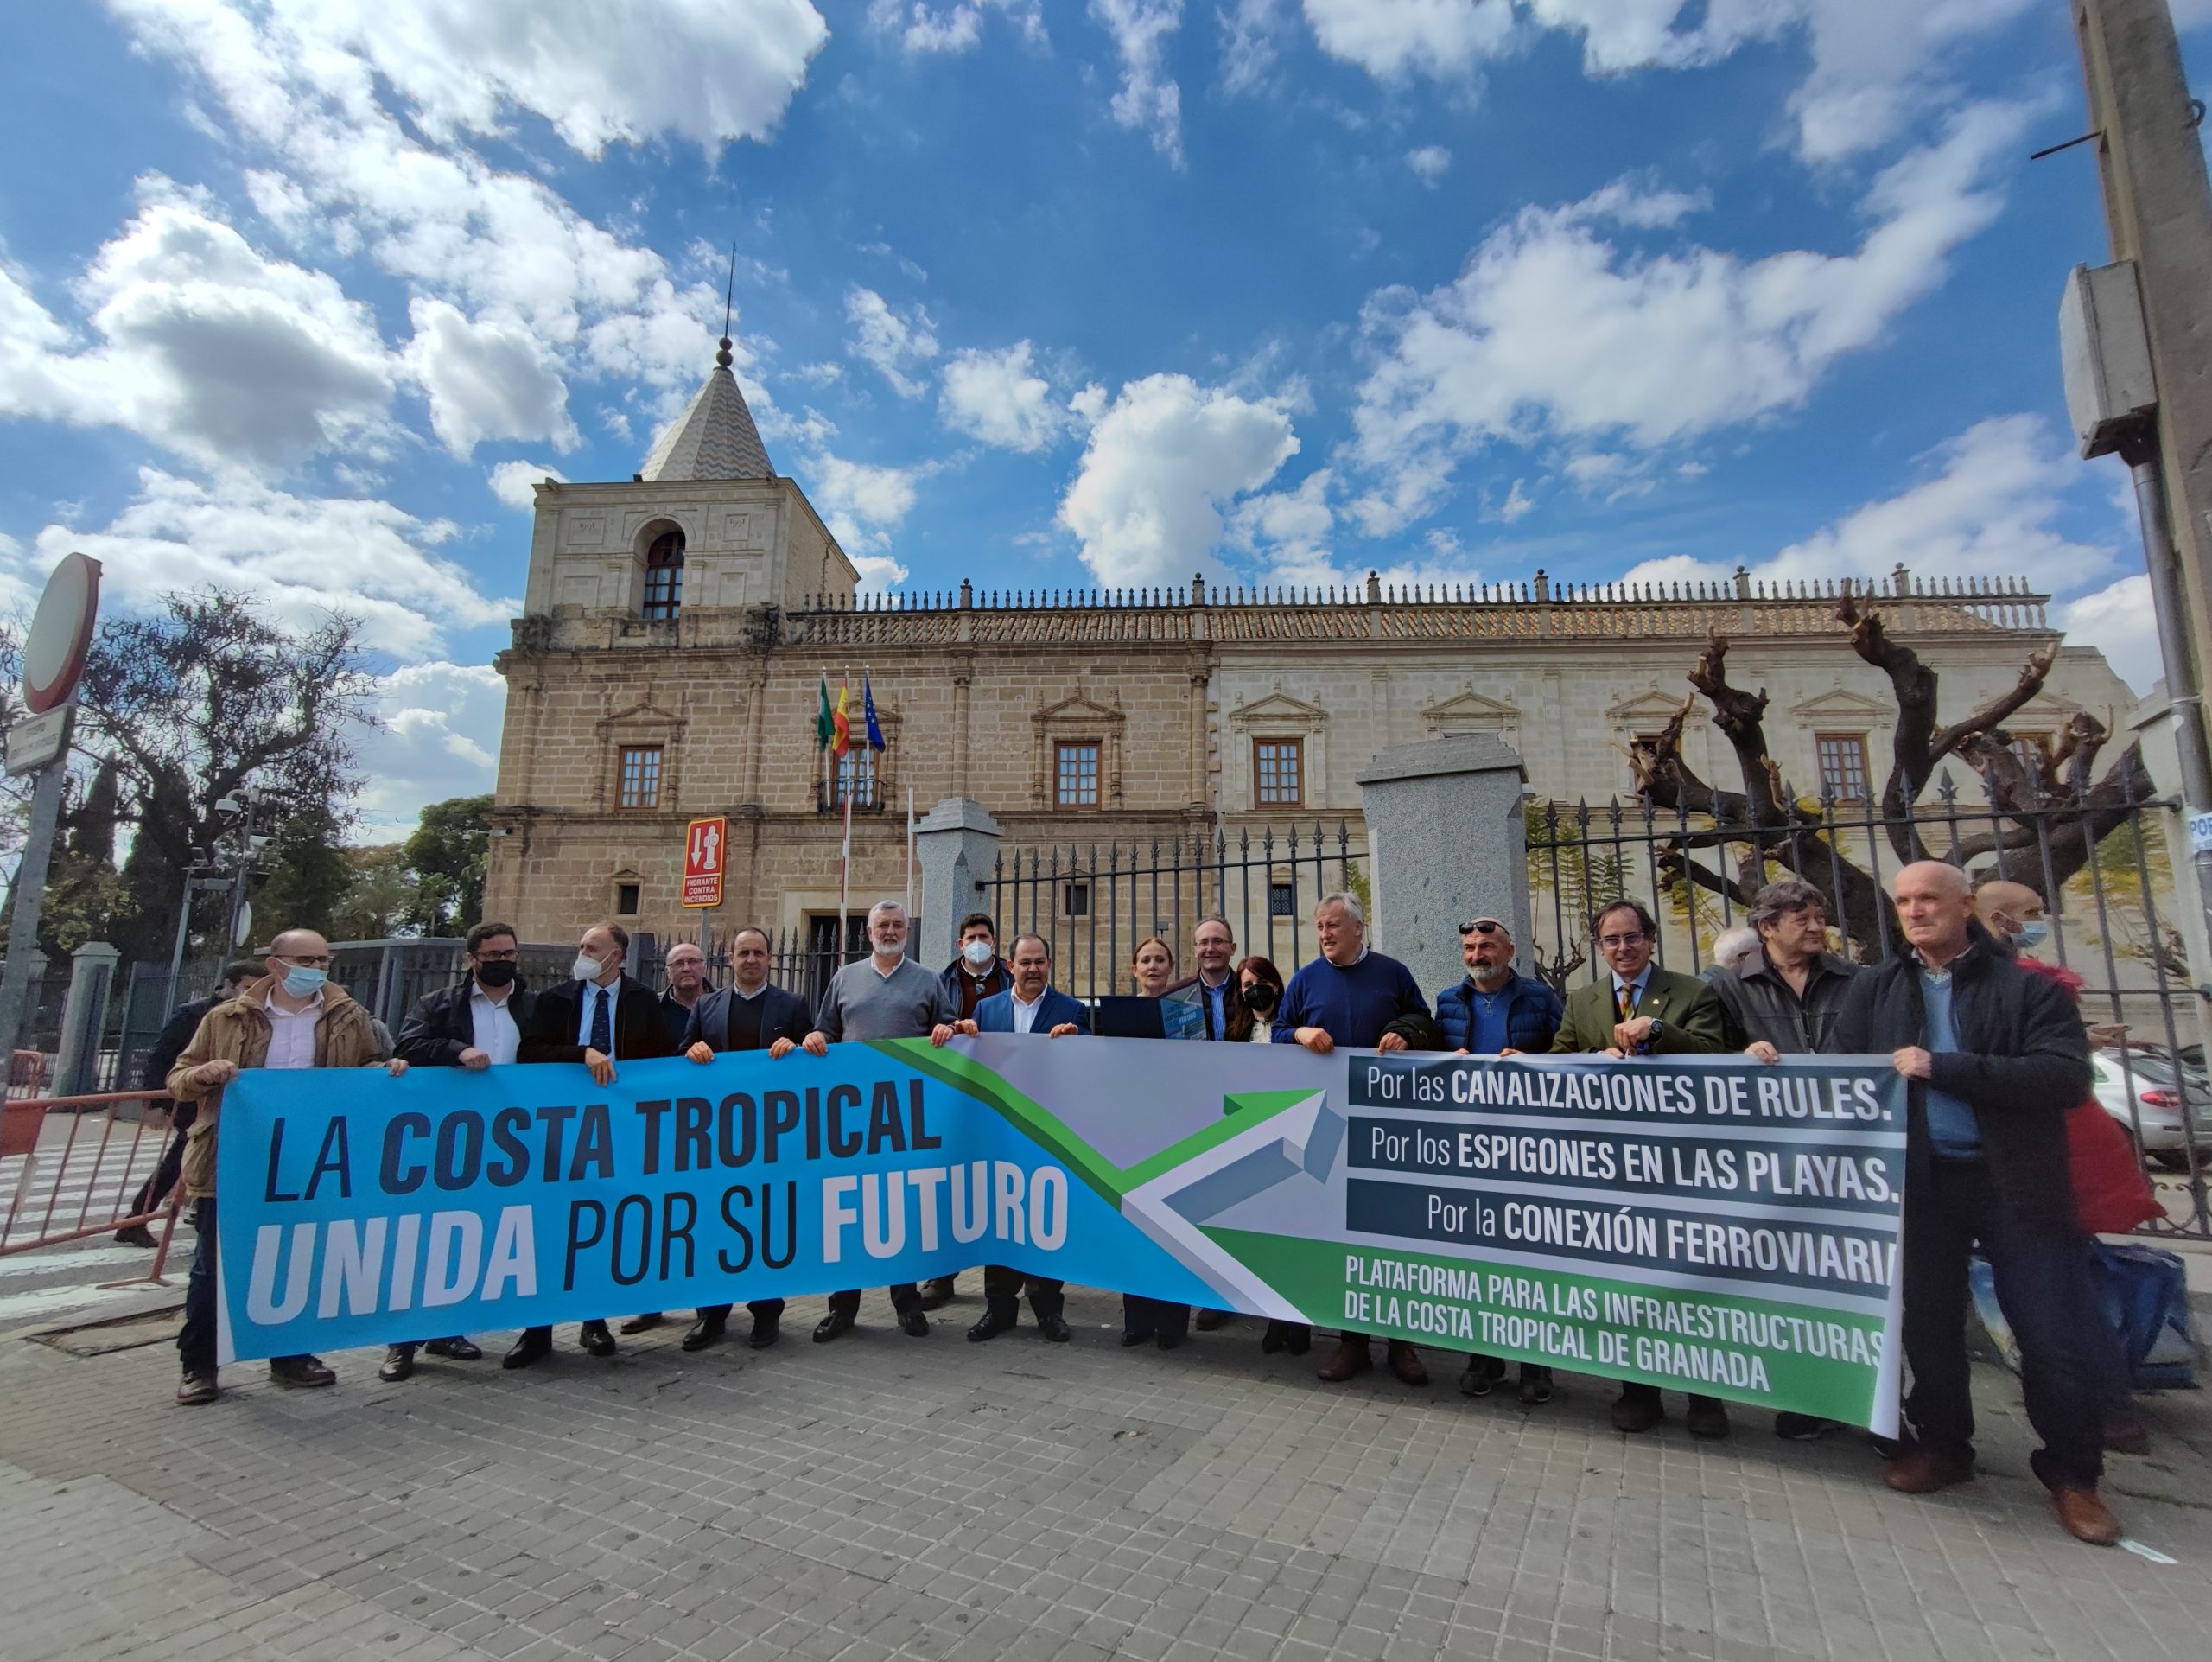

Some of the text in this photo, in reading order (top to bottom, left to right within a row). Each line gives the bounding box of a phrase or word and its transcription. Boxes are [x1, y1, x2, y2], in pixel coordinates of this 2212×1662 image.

[684, 894, 718, 903] INCENDIOS
[687, 877, 718, 887] HIDRANTE
[688, 886, 715, 895] CONTRA
[1367, 1066, 1892, 1121] Por las CANALIZACIONES DE RULES.
[264, 1078, 942, 1203] LA COSTA TROPICAL
[1371, 1126, 1900, 1203] Por los ESPIGONES EN LAS PLAYAS.
[246, 1160, 1068, 1325] UNIDA POR SU FUTURO
[1427, 1194, 1467, 1233] Por
[1475, 1197, 1496, 1237] la
[1504, 1202, 1657, 1258] CONEXIÓN
[1344, 1290, 1770, 1393] DE LA COSTA TROPICAL DE GRANADA
[1345, 1255, 1883, 1368] PLATAFORMA PARA LAS INFRAESTRUCTURAS
